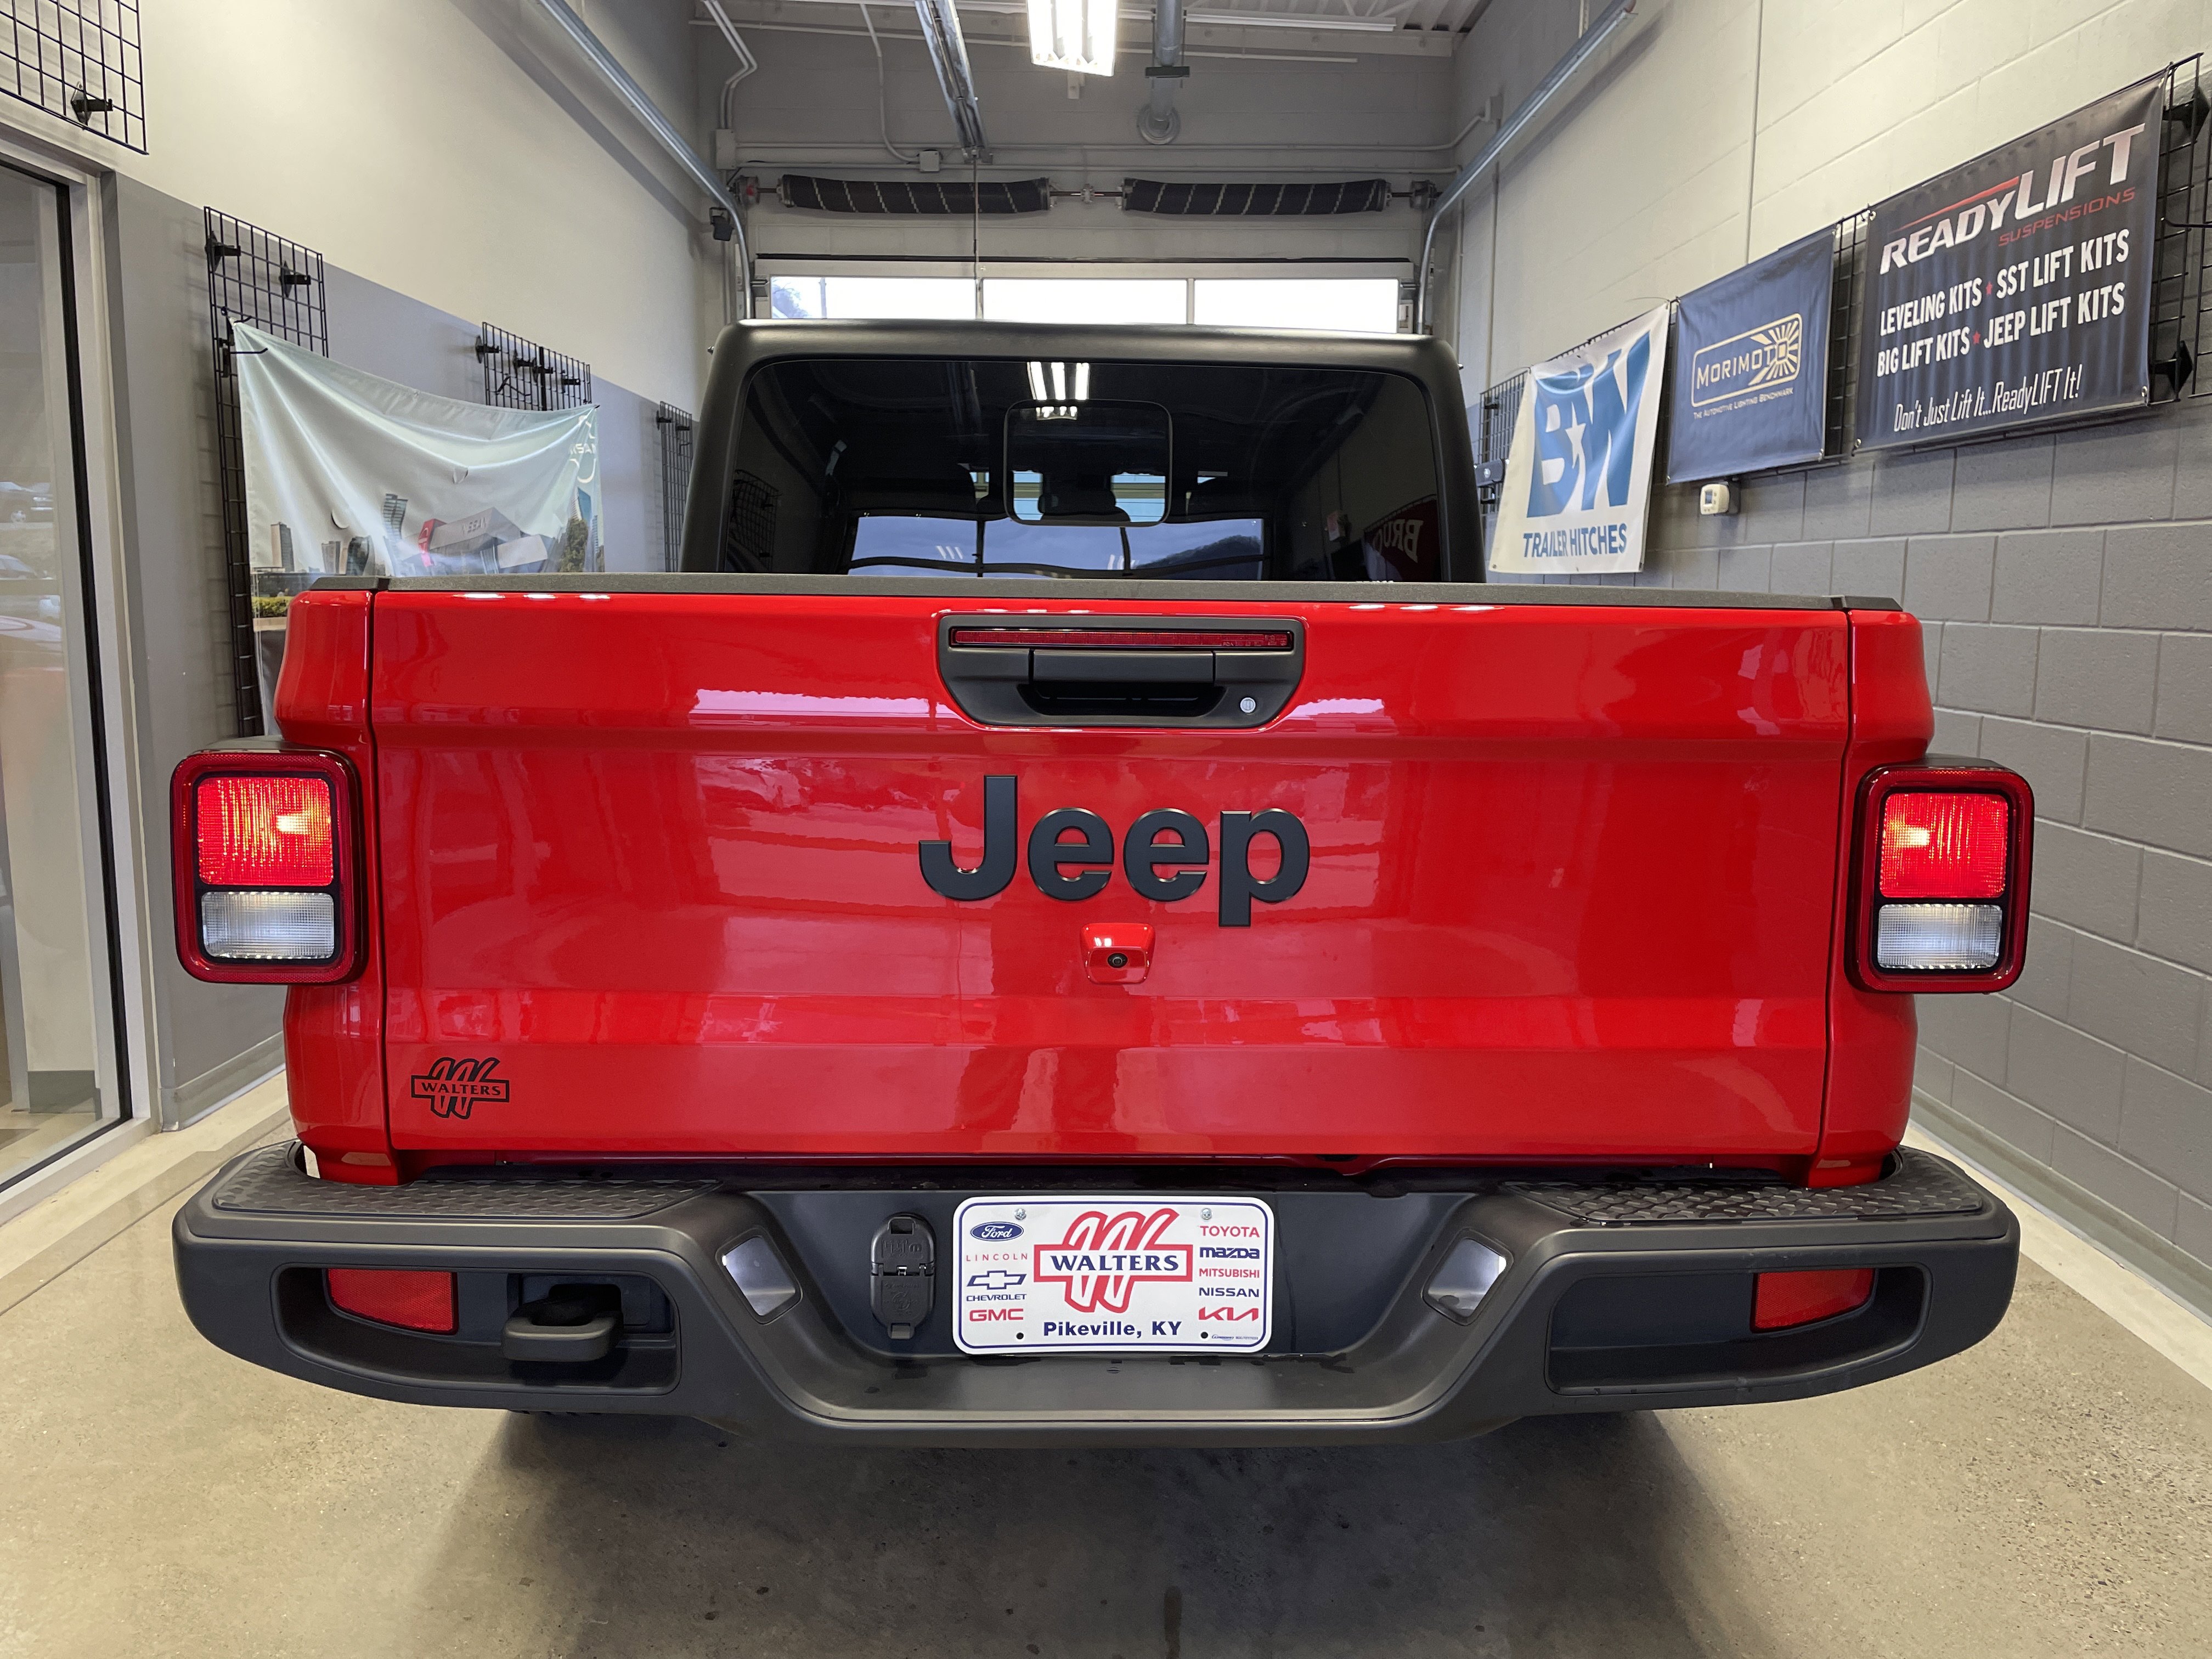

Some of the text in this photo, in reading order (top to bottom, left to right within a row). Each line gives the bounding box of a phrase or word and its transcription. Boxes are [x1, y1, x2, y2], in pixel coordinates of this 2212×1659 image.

[1880, 123, 2145, 274] READYLIFT
[1998, 187, 2135, 246] SUSPENSIONS
[1880, 229, 2129, 336] LEVELING KITS SST LIFT KITS
[1877, 282, 2125, 377] BIG LIFT KITS JEEP LIFT KITS
[1697, 338, 1788, 390] MORIMOTO
[1894, 400, 1922, 432] Don't
[1923, 397, 1950, 427] Just
[1951, 388, 1973, 421] Lift
[2063, 364, 2083, 400] It!
[1523, 522, 1627, 557] TRAILER HITCHES
[919, 775, 1310, 927] Jeep
[421, 1082, 501, 1096] WALTERS
[981, 1224, 1012, 1238] Ford
[1199, 1225, 1260, 1238] TOYOTA
[966, 1253, 1028, 1261] LINCOLN
[1050, 1255, 1179, 1271] WALTERS
[1199, 1268, 1260, 1278] MITSUBISHI
[966, 1294, 1026, 1302] CHEVROLET
[1199, 1287, 1259, 1297] NISSAN
[969, 1308, 1024, 1322] GMC
[1198, 1306, 1259, 1321] KIA
[1043, 1321, 1182, 1339] Pikeville, KY
